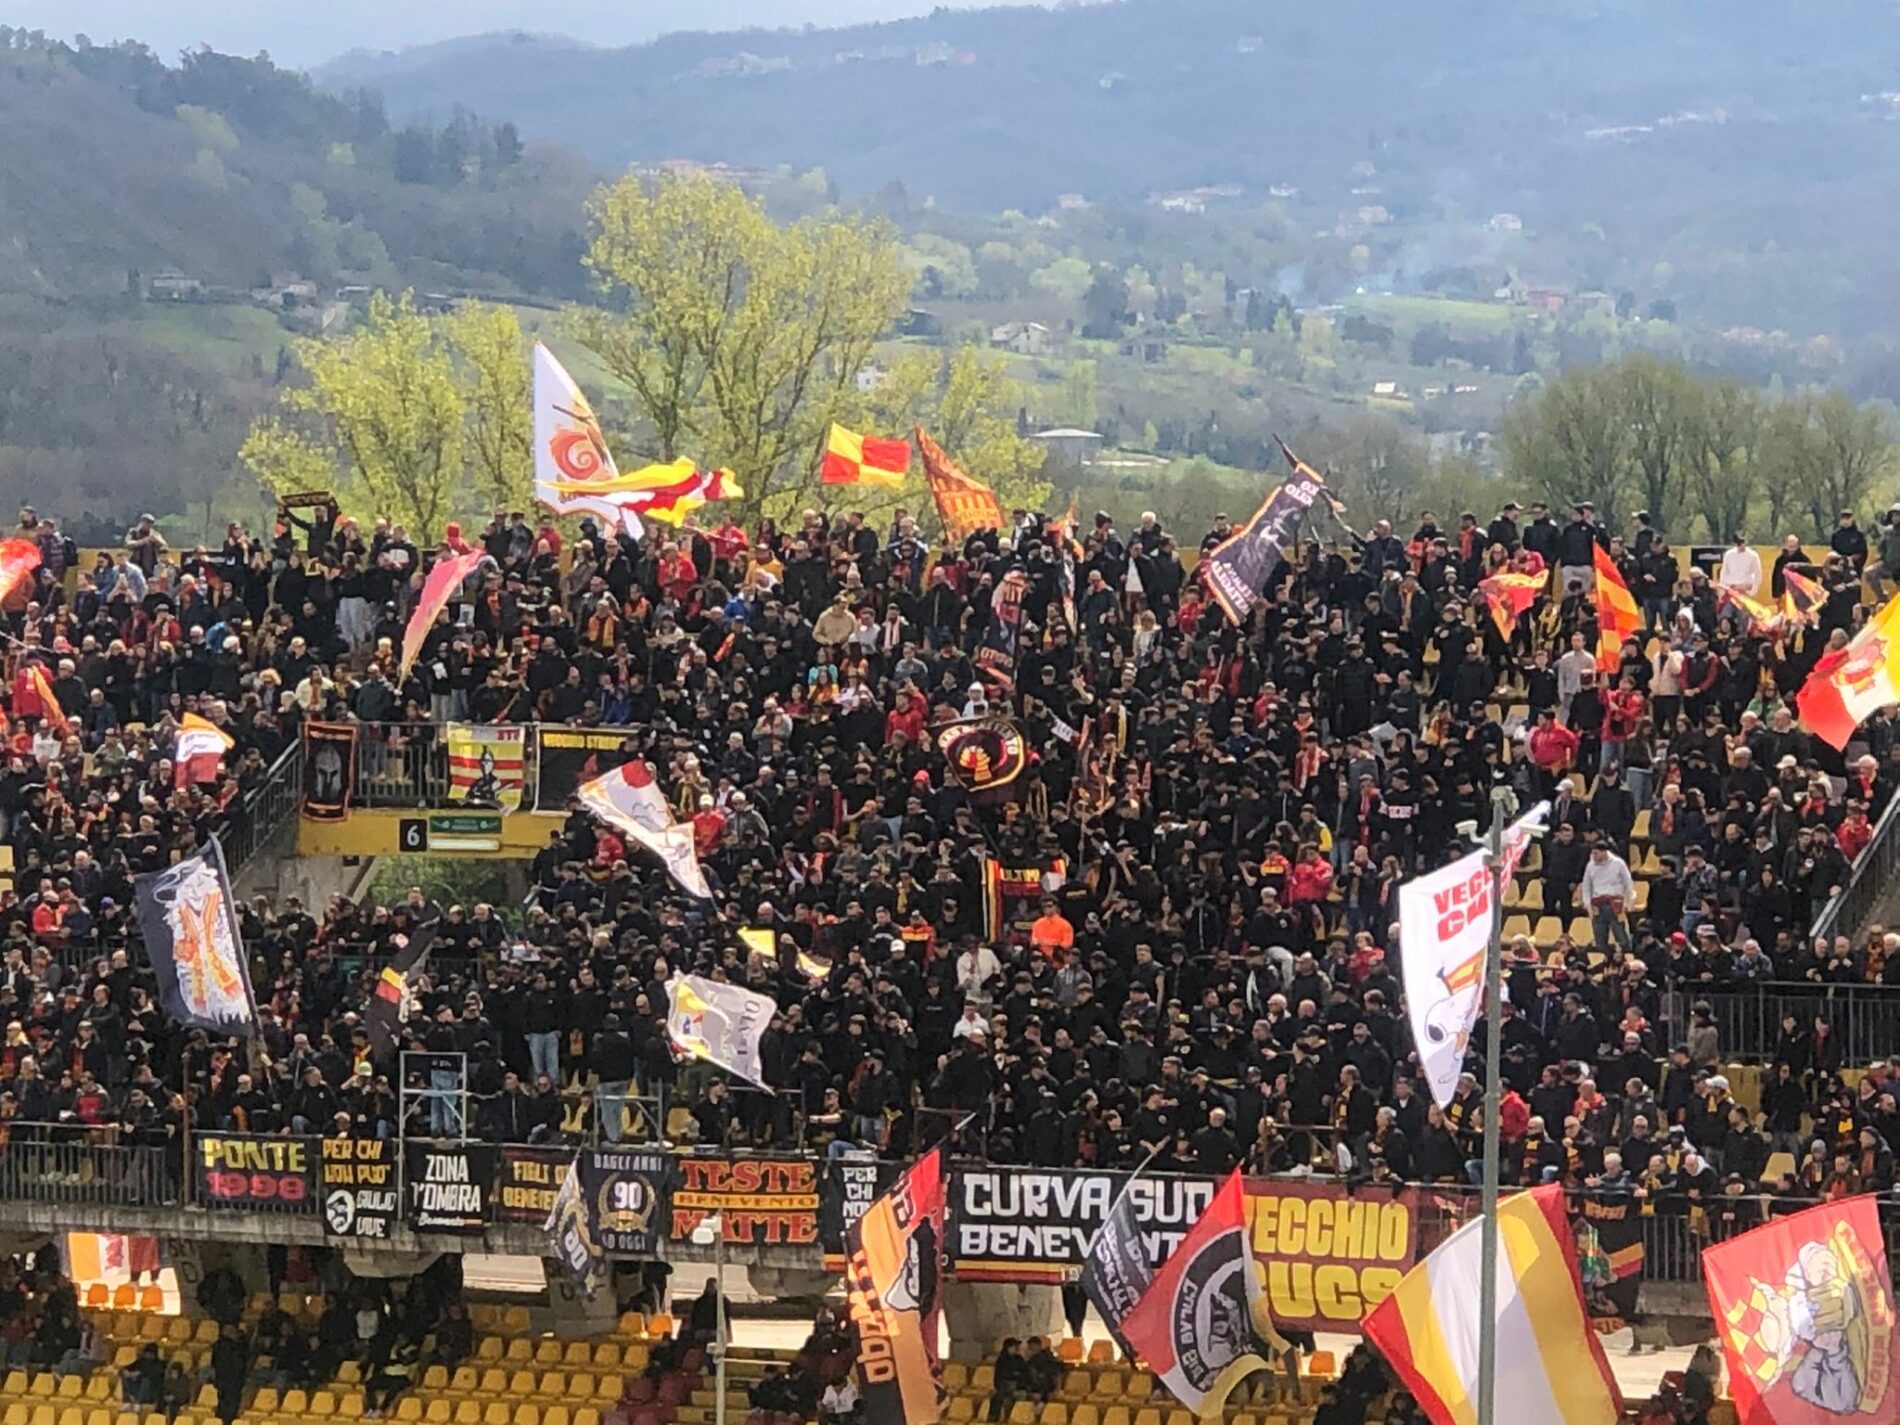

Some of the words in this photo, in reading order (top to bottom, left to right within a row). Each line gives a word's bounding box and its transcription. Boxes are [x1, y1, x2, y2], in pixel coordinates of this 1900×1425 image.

[407, 825, 420, 846] 6
[204, 1138, 307, 1172] PONTE
[425, 1154, 470, 1182] ZONA
[679, 1160, 817, 1193] TESTE
[842, 1166, 878, 1182] PER
[614, 1182, 642, 1209] 90
[678, 1194, 817, 1207] BENEVENTO
[845, 1183, 873, 1200] CHI
[963, 1173, 1111, 1220] CURVA
[1128, 1180, 1214, 1224] SUD
[959, 1224, 1188, 1263] BENEVNT
